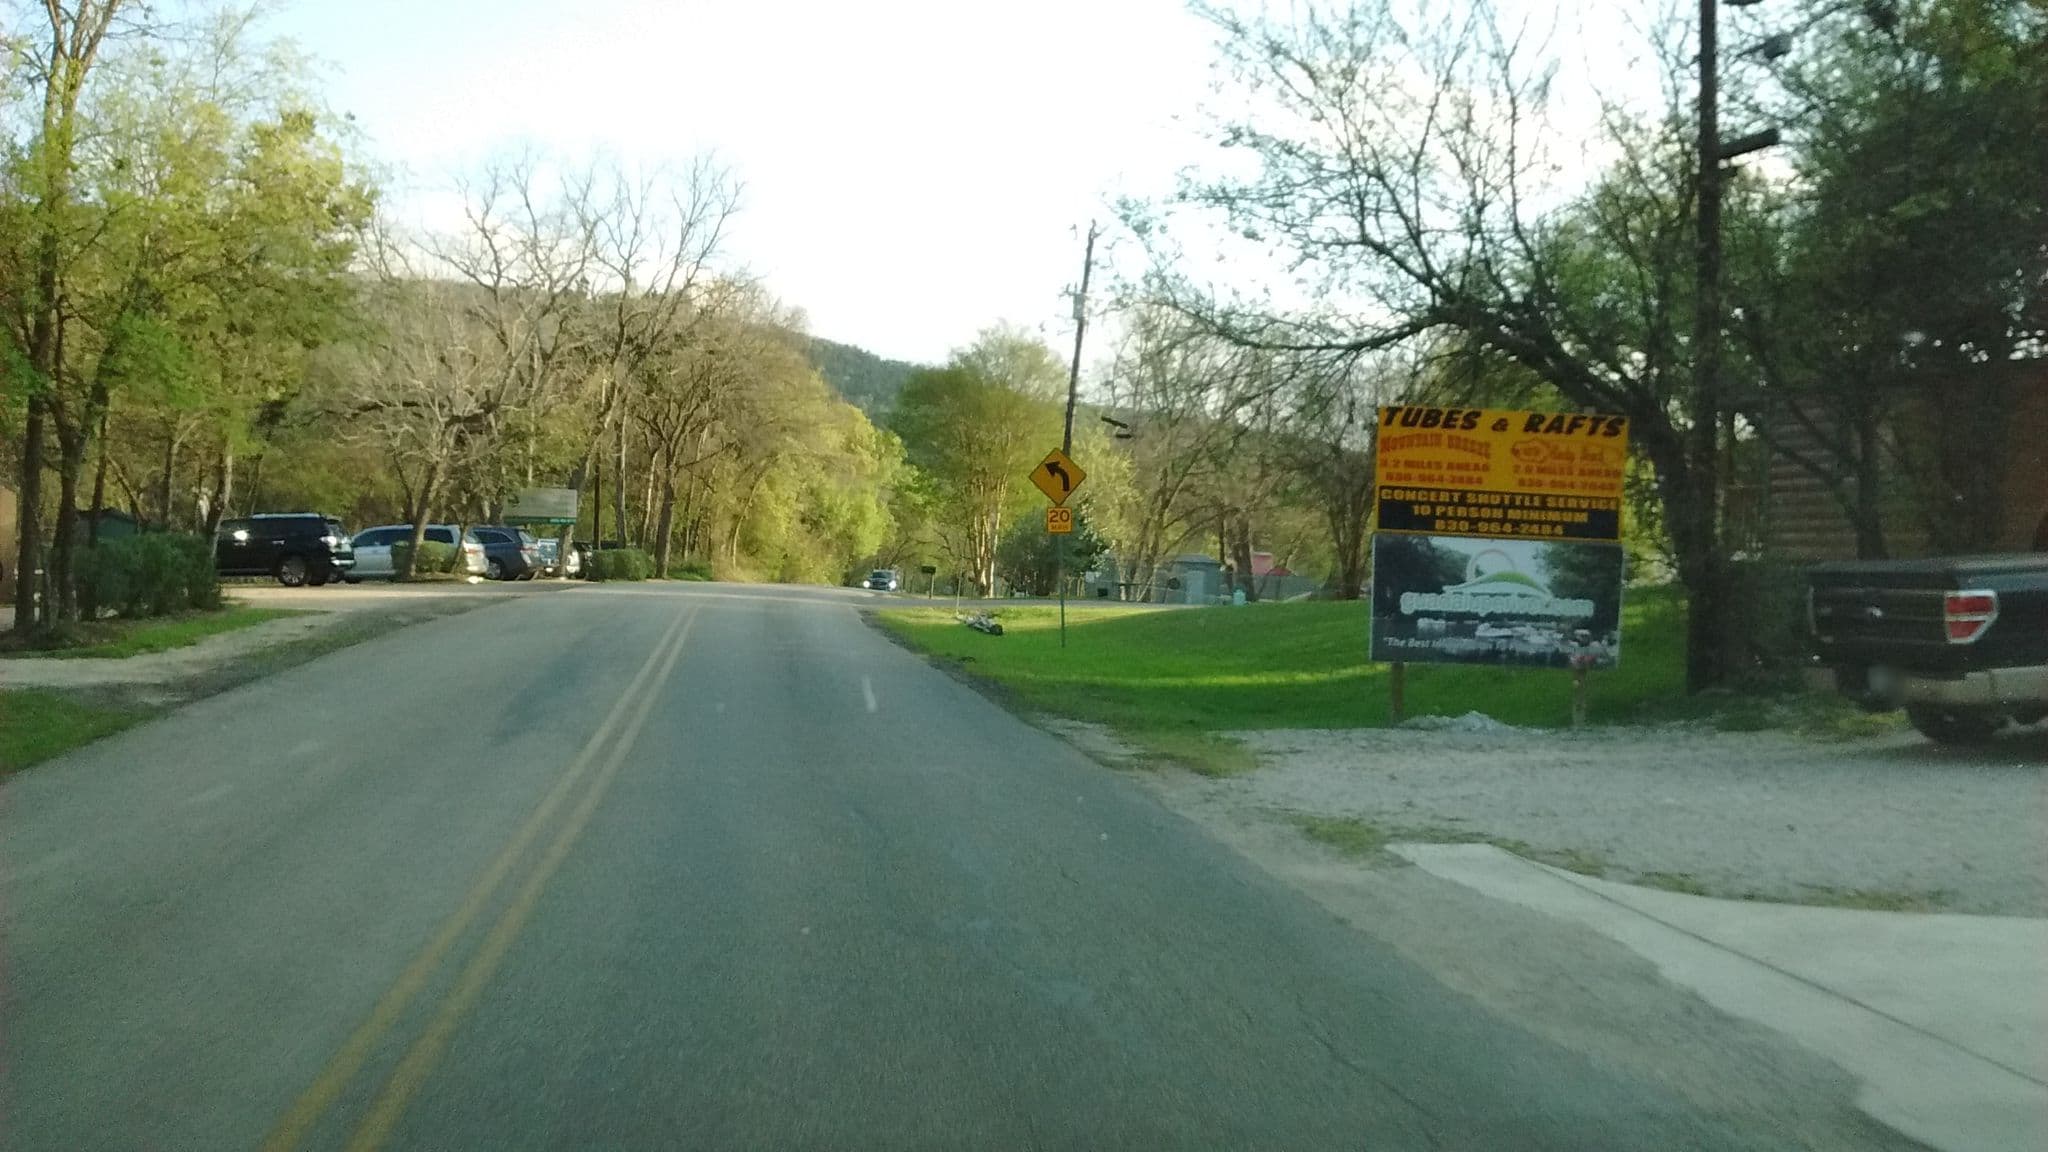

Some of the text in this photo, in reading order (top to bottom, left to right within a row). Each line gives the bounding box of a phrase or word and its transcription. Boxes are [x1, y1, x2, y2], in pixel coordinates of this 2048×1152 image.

[1384, 407, 1625, 436] TUBES & RAFTS
[1381, 489, 1617, 510] CONCERT SHUTTLE SERVICE
[1049, 509, 1070, 523] 20
[1413, 504, 1588, 522] 10 PERSON MINIMUM
